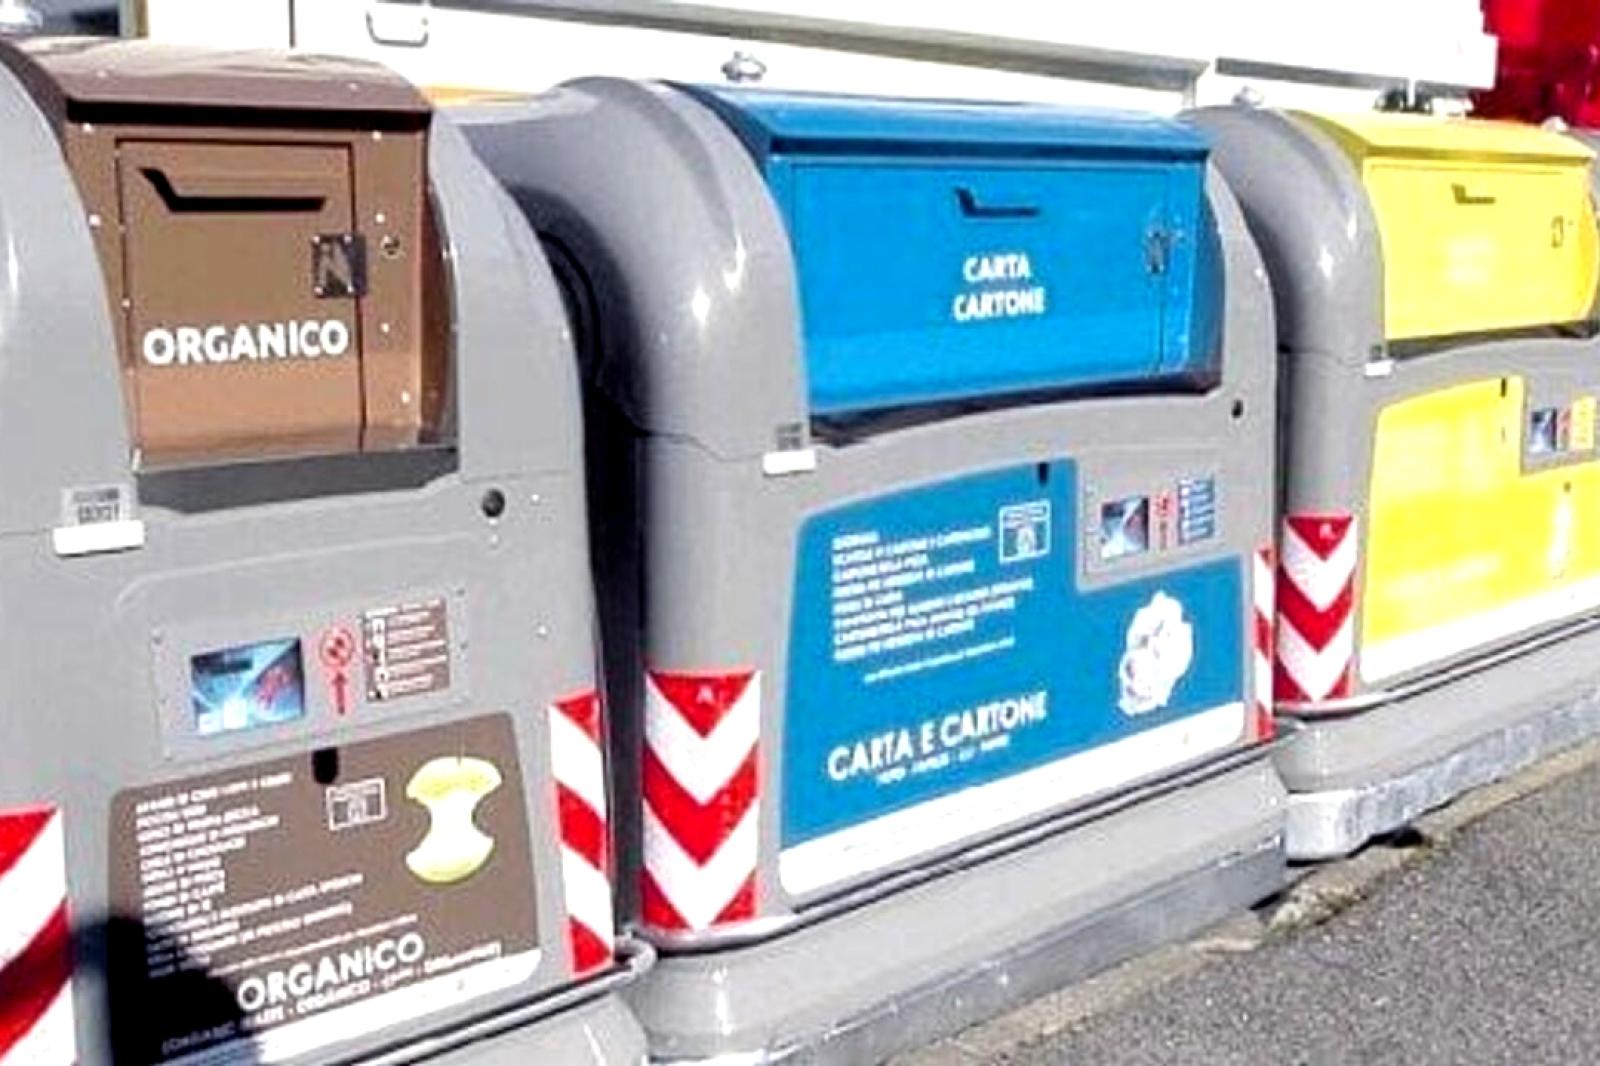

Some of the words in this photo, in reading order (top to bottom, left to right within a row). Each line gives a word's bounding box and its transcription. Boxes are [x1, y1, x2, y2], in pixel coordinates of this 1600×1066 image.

[963, 252, 1031, 282] CARTA
[953, 286, 1046, 322] CARTONE
[143, 319, 349, 365] ORGANICO
[827, 728, 914, 781] CARTA
[920, 721, 935, 754] E
[940, 690, 1048, 747] CARTONE
[236, 932, 425, 1011] ORGANICO
